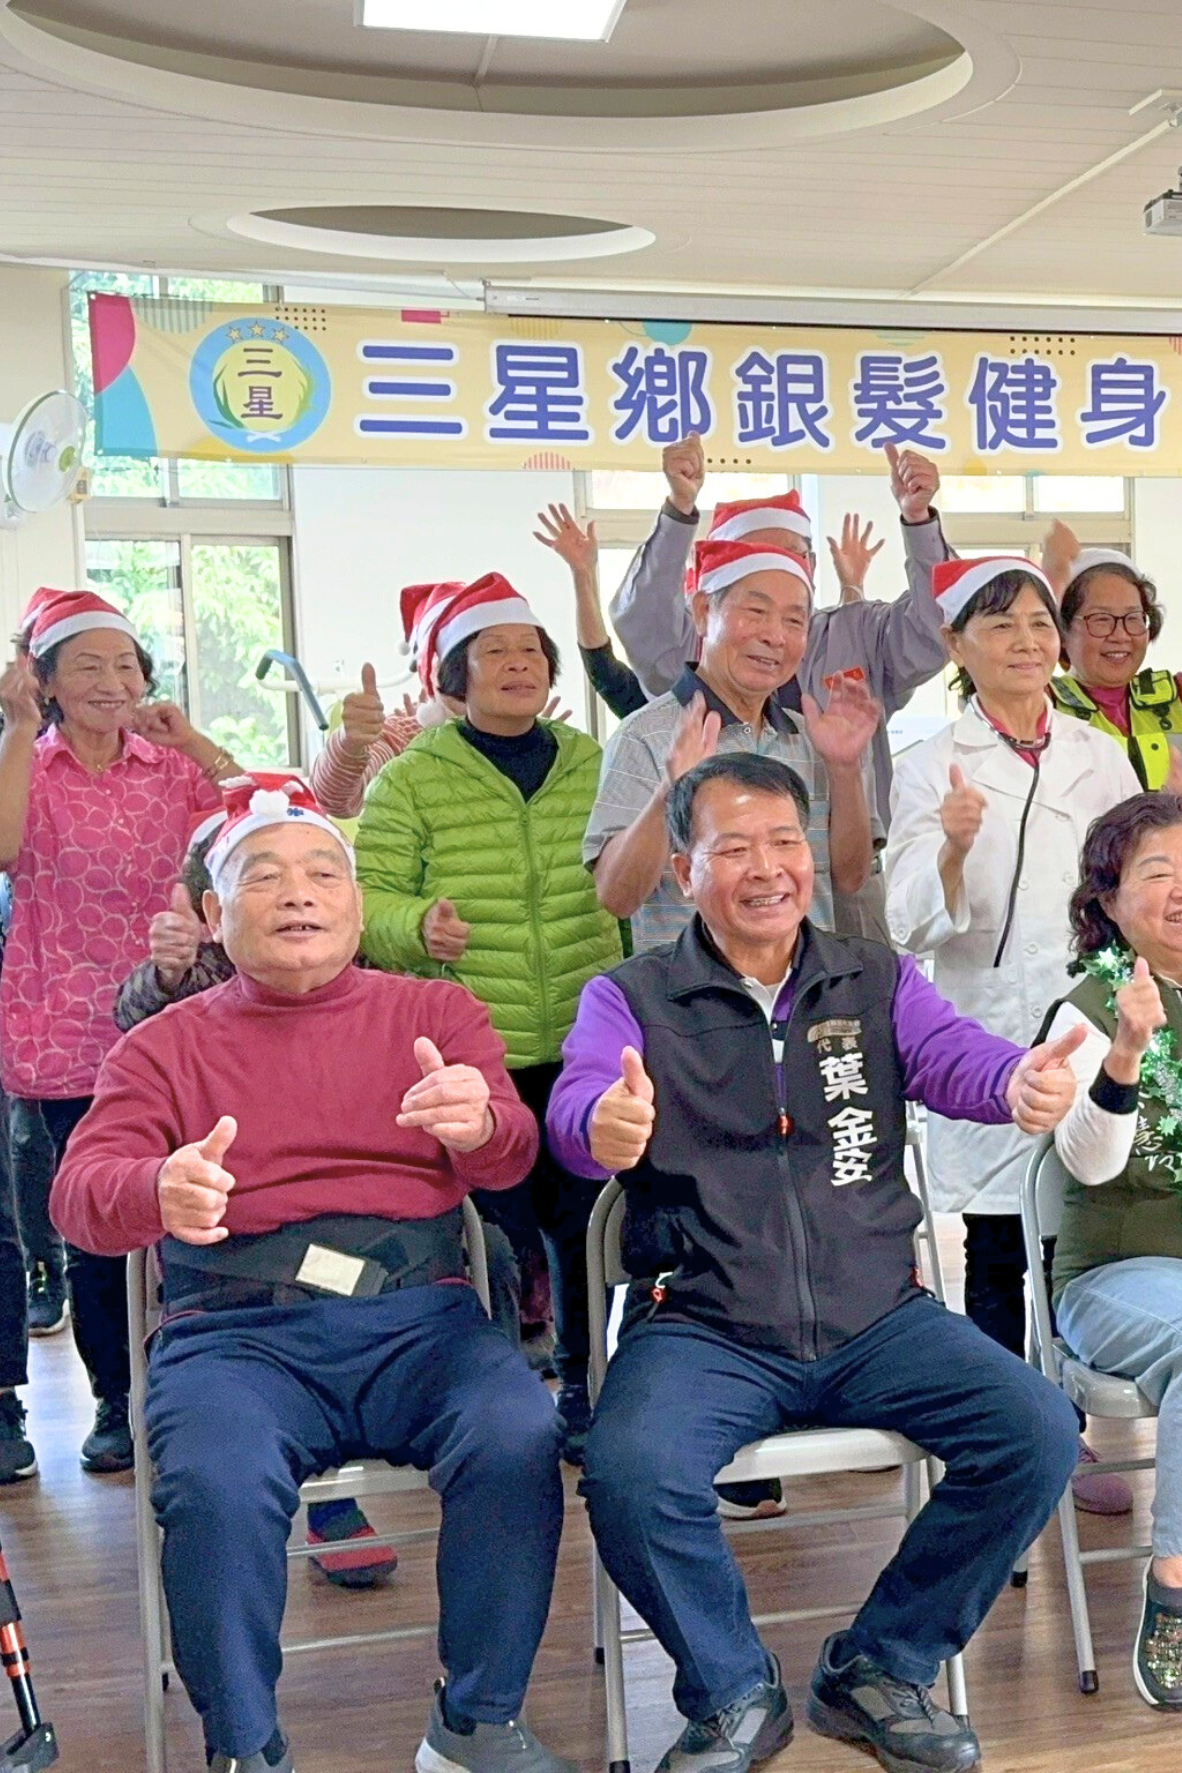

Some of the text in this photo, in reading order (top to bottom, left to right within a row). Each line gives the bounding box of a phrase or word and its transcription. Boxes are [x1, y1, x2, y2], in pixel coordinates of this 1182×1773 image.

[237, 346, 284, 420] 三星
[818, 1052, 878, 1187] 葉金安
